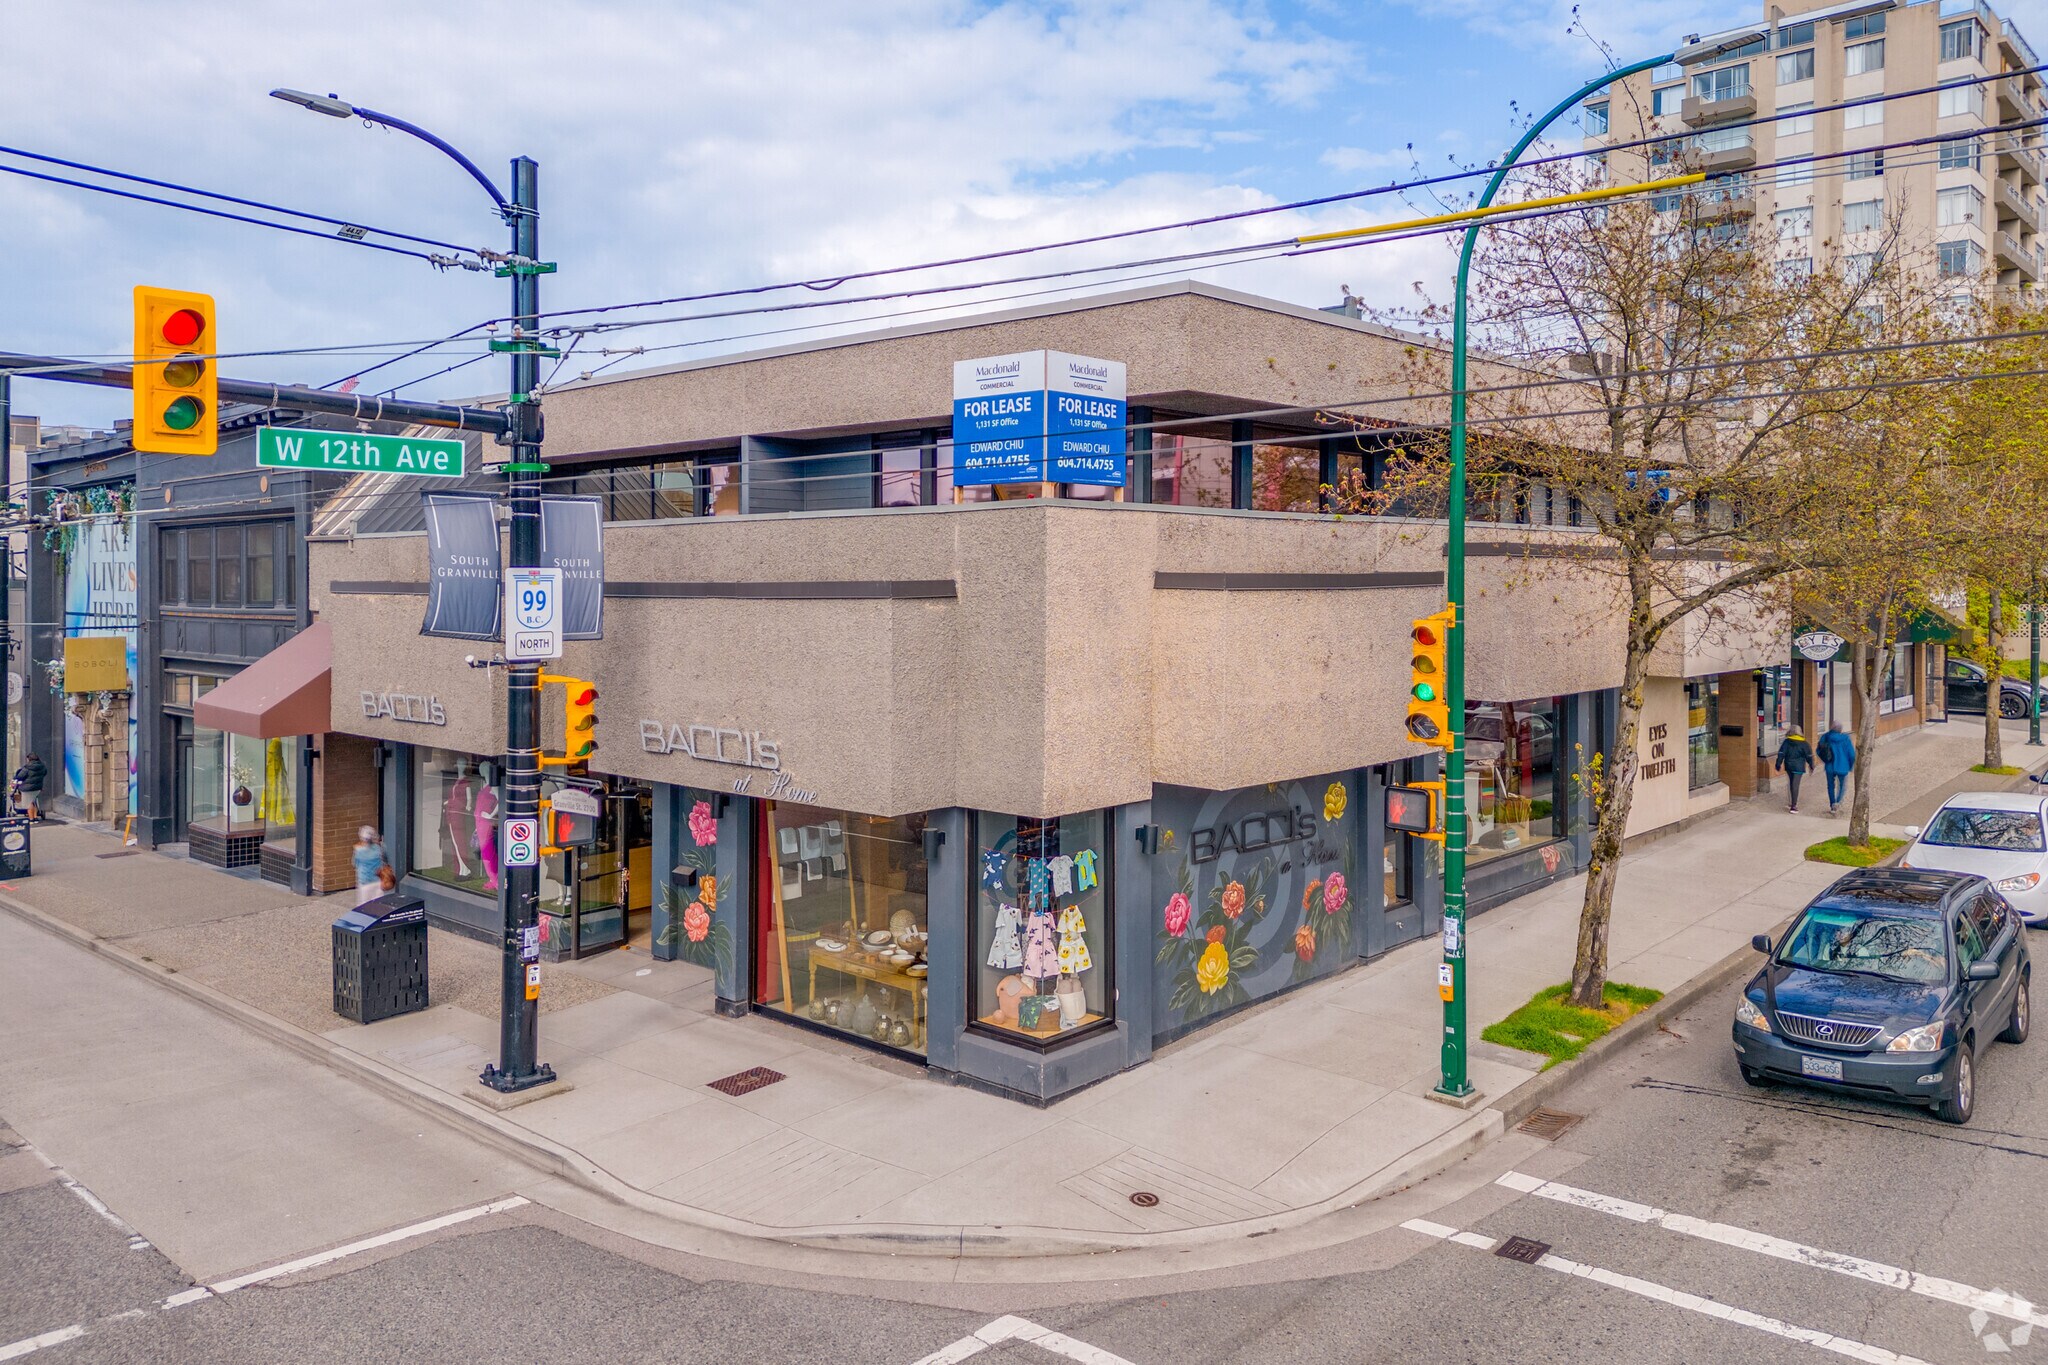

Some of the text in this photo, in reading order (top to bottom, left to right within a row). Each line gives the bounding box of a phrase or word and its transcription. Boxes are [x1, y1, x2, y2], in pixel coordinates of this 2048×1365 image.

[976, 361, 1020, 376] Macdonald
[1069, 362, 1107, 378] Macdonald
[980, 381, 1014, 390] COMMERCIAL
[1073, 381, 1104, 391] COMMERCIAL
[964, 396, 1032, 417] FOR LEASE
[1058, 397, 1117, 419] FOR LEASE
[975, 417, 1019, 429] 1,131 SF Office
[1070, 418, 1108, 429] 1,131 SF Office
[275, 436, 449, 471] W 12th Ave
[970, 439, 1024, 453] EDWARD CHIU
[1063, 441, 1110, 454] EDWARD CHIU
[965, 454, 1030, 470] 604.714.4755
[1058, 456, 1114, 471] 604.714.4755
[450, 554, 488, 566] SOUTH
[554, 558, 590, 567] SOUTH
[92, 561, 136, 592] LIVES
[562, 570, 600, 578] NVILLE
[523, 590, 546, 611] 99
[93, 601, 135, 632] HERE
[526, 616, 544, 624] B.C.
[520, 638, 550, 648] NORTH
[74, 660, 118, 668] BOBOLI
[1649, 723, 1667, 741] EYES
[1652, 742, 1664, 759] ON
[1641, 758, 1676, 780] TWELFTH
[733, 770, 818, 803] at Home
